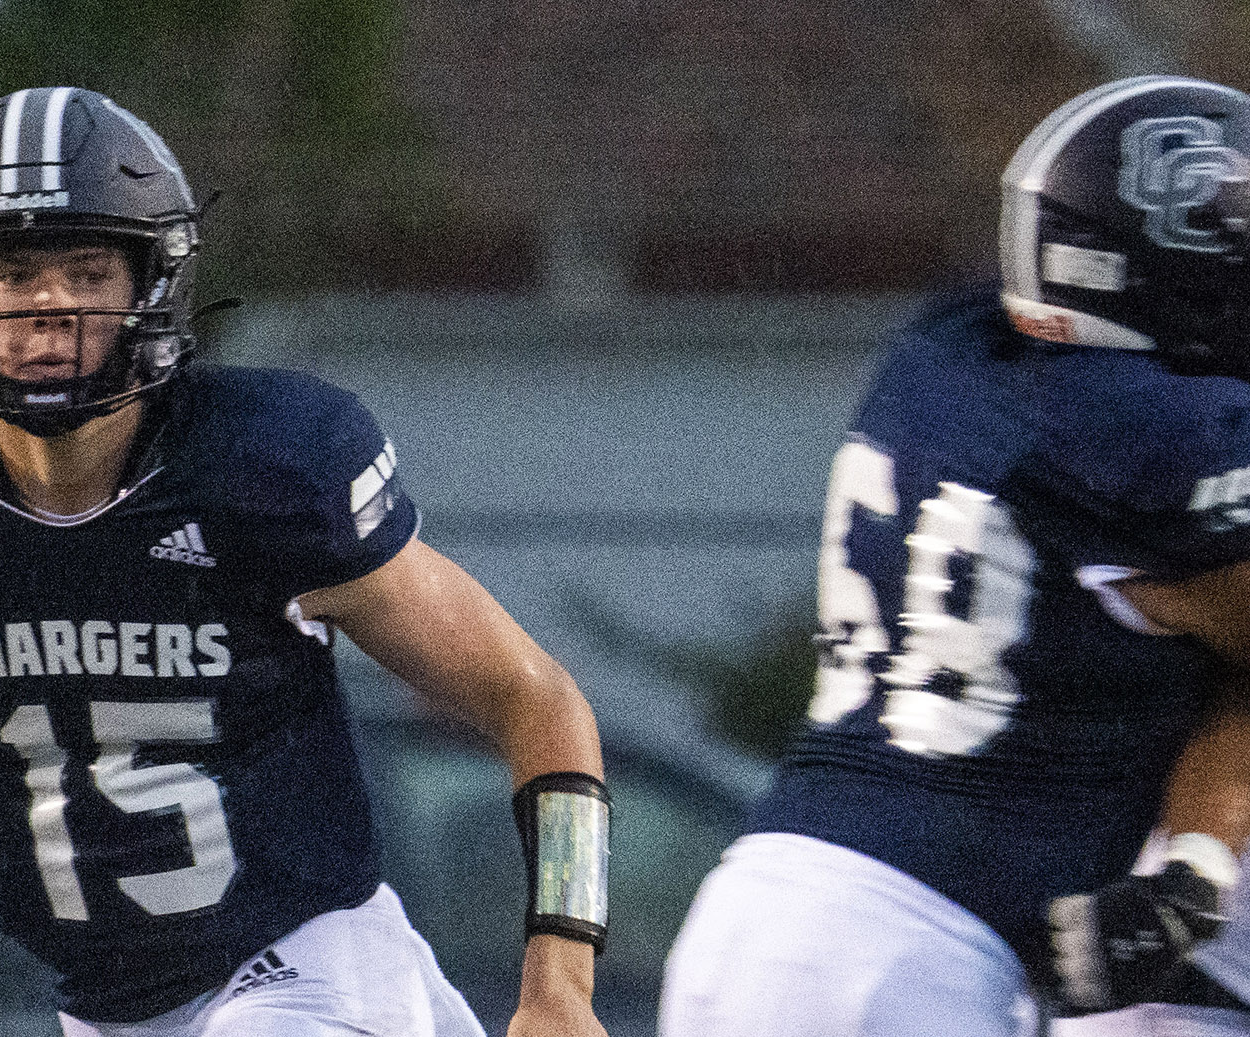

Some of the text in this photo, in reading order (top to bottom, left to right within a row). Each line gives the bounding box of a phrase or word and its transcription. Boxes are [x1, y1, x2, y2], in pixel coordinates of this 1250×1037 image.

[149, 545, 217, 568] adidas
[807, 434, 1038, 758] 68
[0, 698, 237, 921] 15
